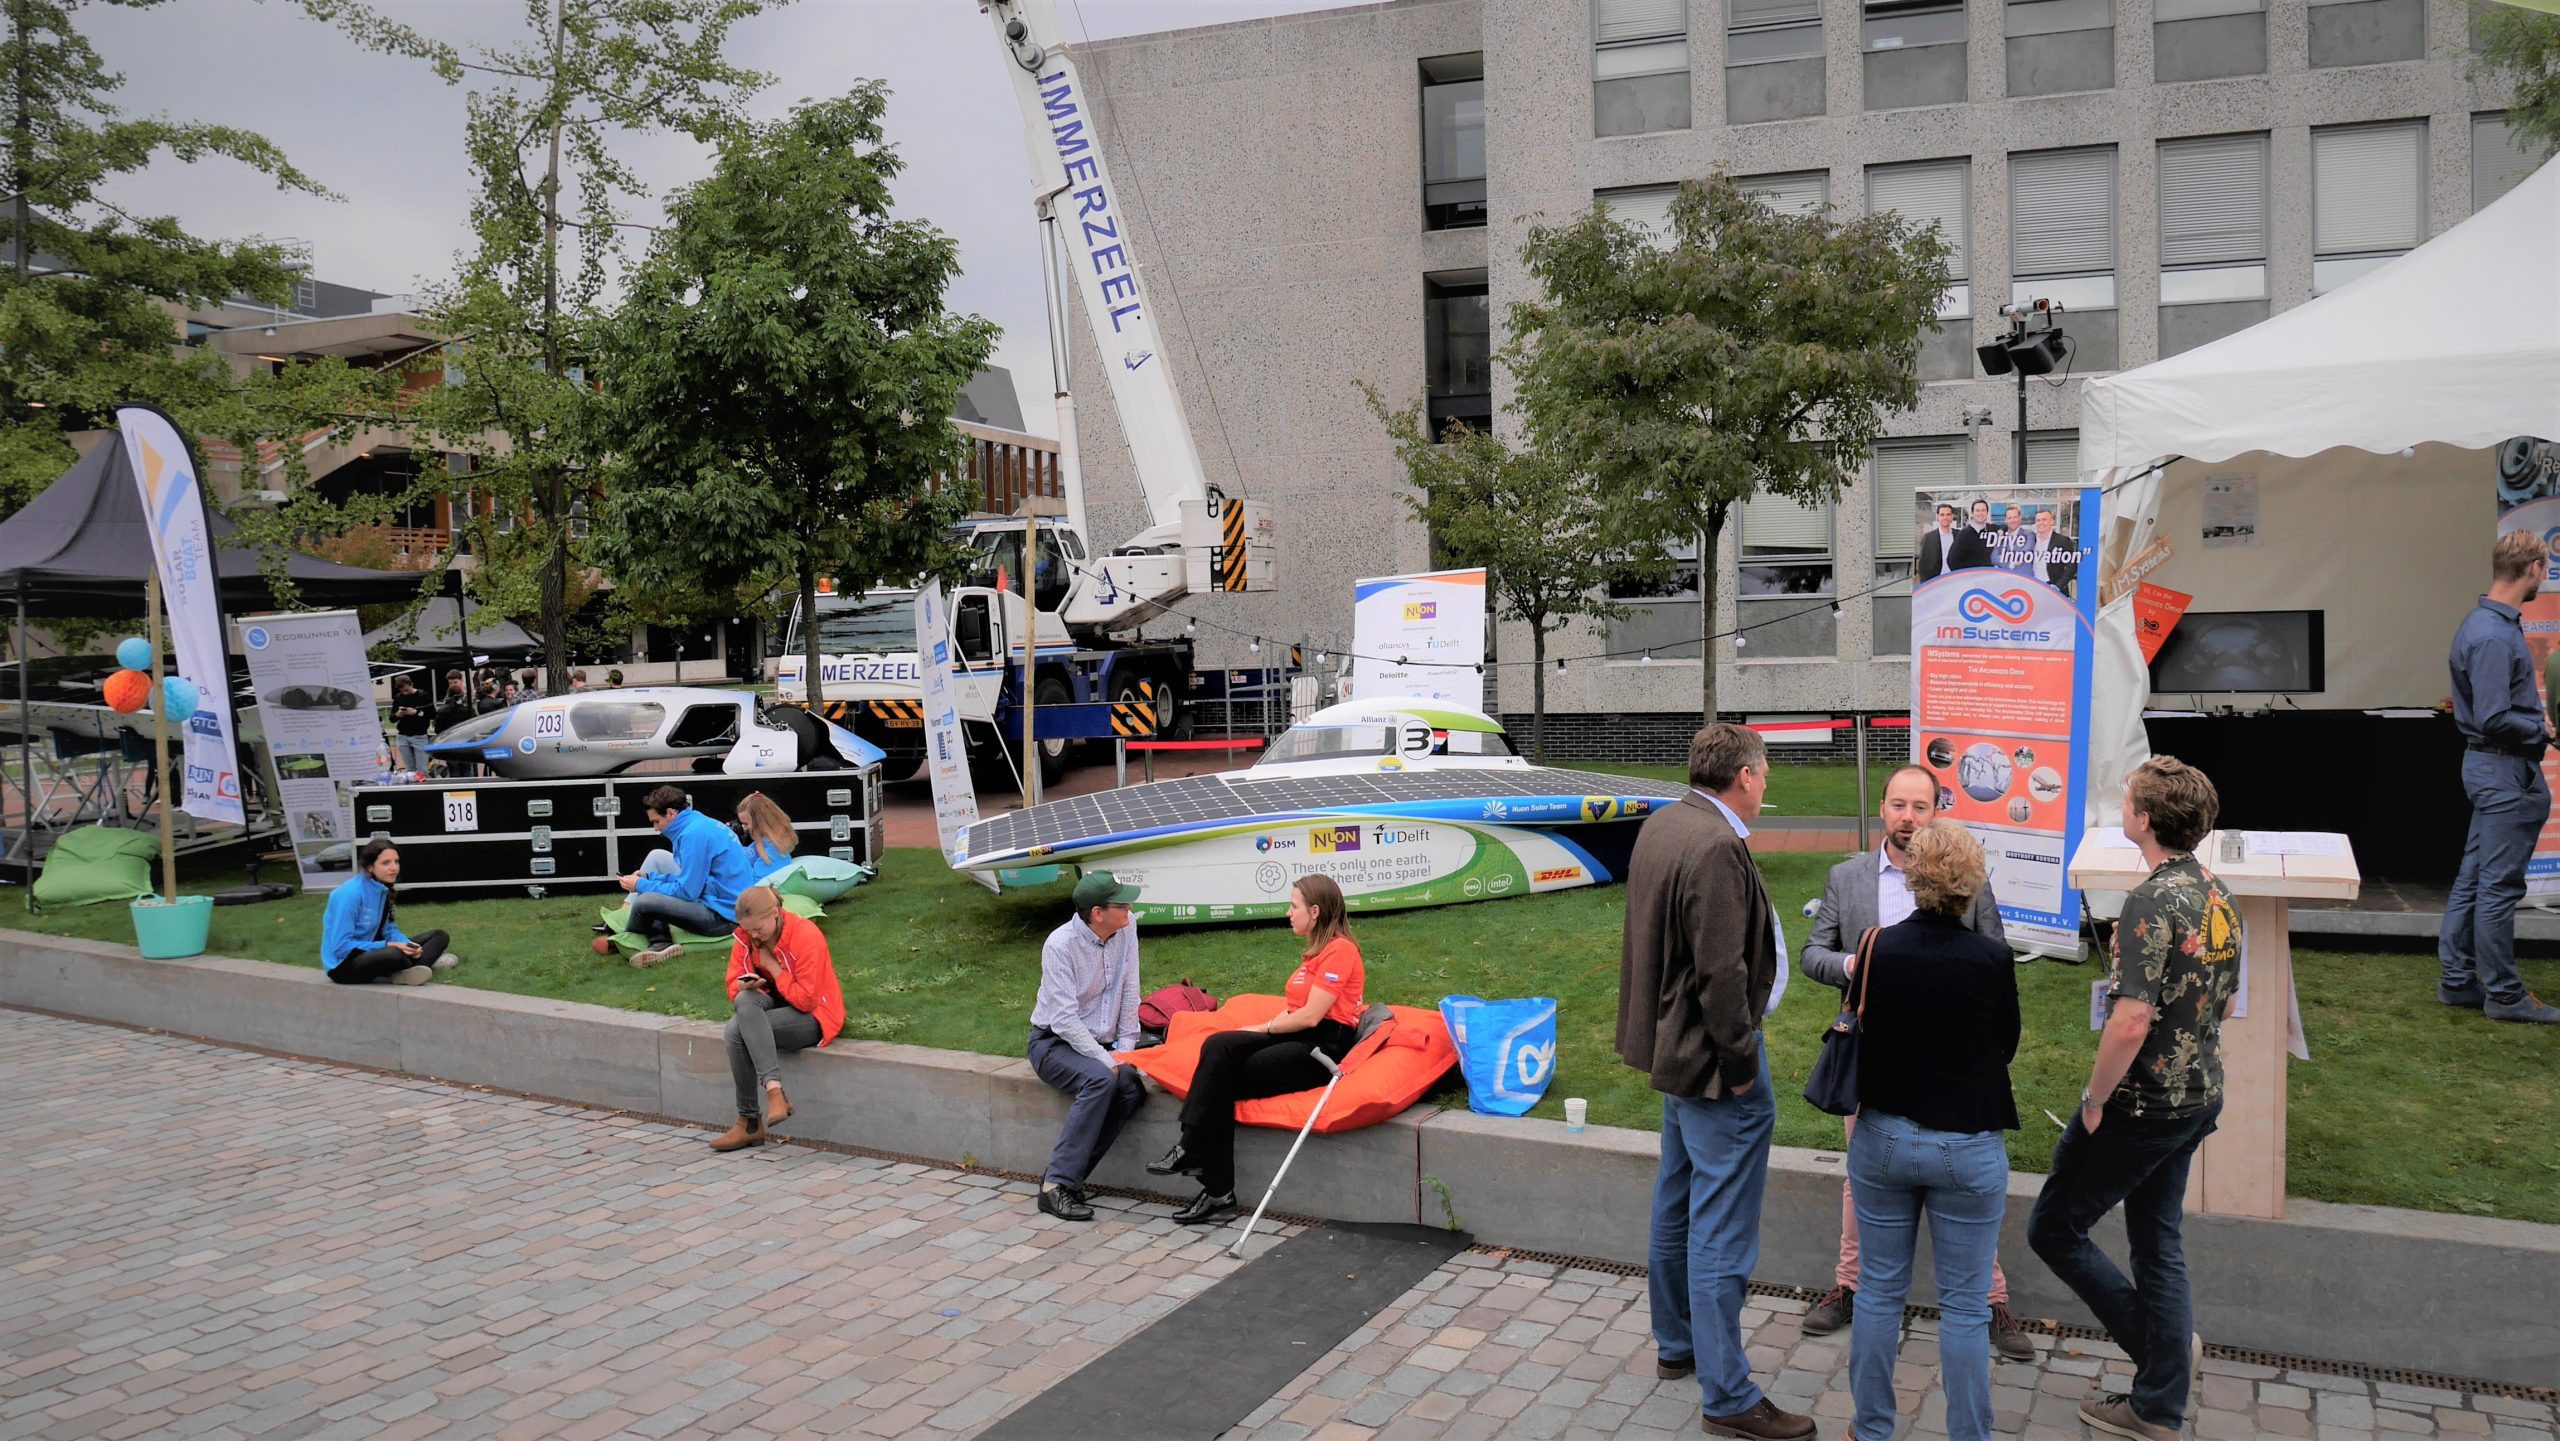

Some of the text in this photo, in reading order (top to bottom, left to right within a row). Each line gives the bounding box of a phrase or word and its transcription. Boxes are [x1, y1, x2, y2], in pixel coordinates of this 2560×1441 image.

[1037, 71, 1141, 333] IMMERZEEL
[1979, 532, 2026, 548] “Drive
[181, 537, 197, 581] BOAT
[2000, 547, 2091, 564] Innovation”
[174, 550, 187, 605] SOLAR
[1406, 605, 1434, 617] NUON
[1937, 626, 2050, 642] IMSystems
[2523, 621, 2560, 632] EARBO
[799, 663, 921, 682] IMERZEEL
[537, 714, 562, 734] 203
[1361, 715, 1387, 723] Allianz
[1404, 728, 1431, 752] 3
[448, 802, 473, 823] 318
[1511, 802, 1568, 812] Nuon Solar Team
[1626, 802, 1648, 812] NUON
[1274, 840, 1296, 849] DSM
[1313, 830, 1357, 848] NUON
[1291, 853, 1431, 875] There's only one earth.
[1332, 865, 1431, 884] there's no spare!
[1490, 877, 1510, 888] intel
[1540, 869, 1575, 880] DHL
[2015, 911, 2047, 923] SYSTEMS
[2051, 917, 2072, 927] B.V.
